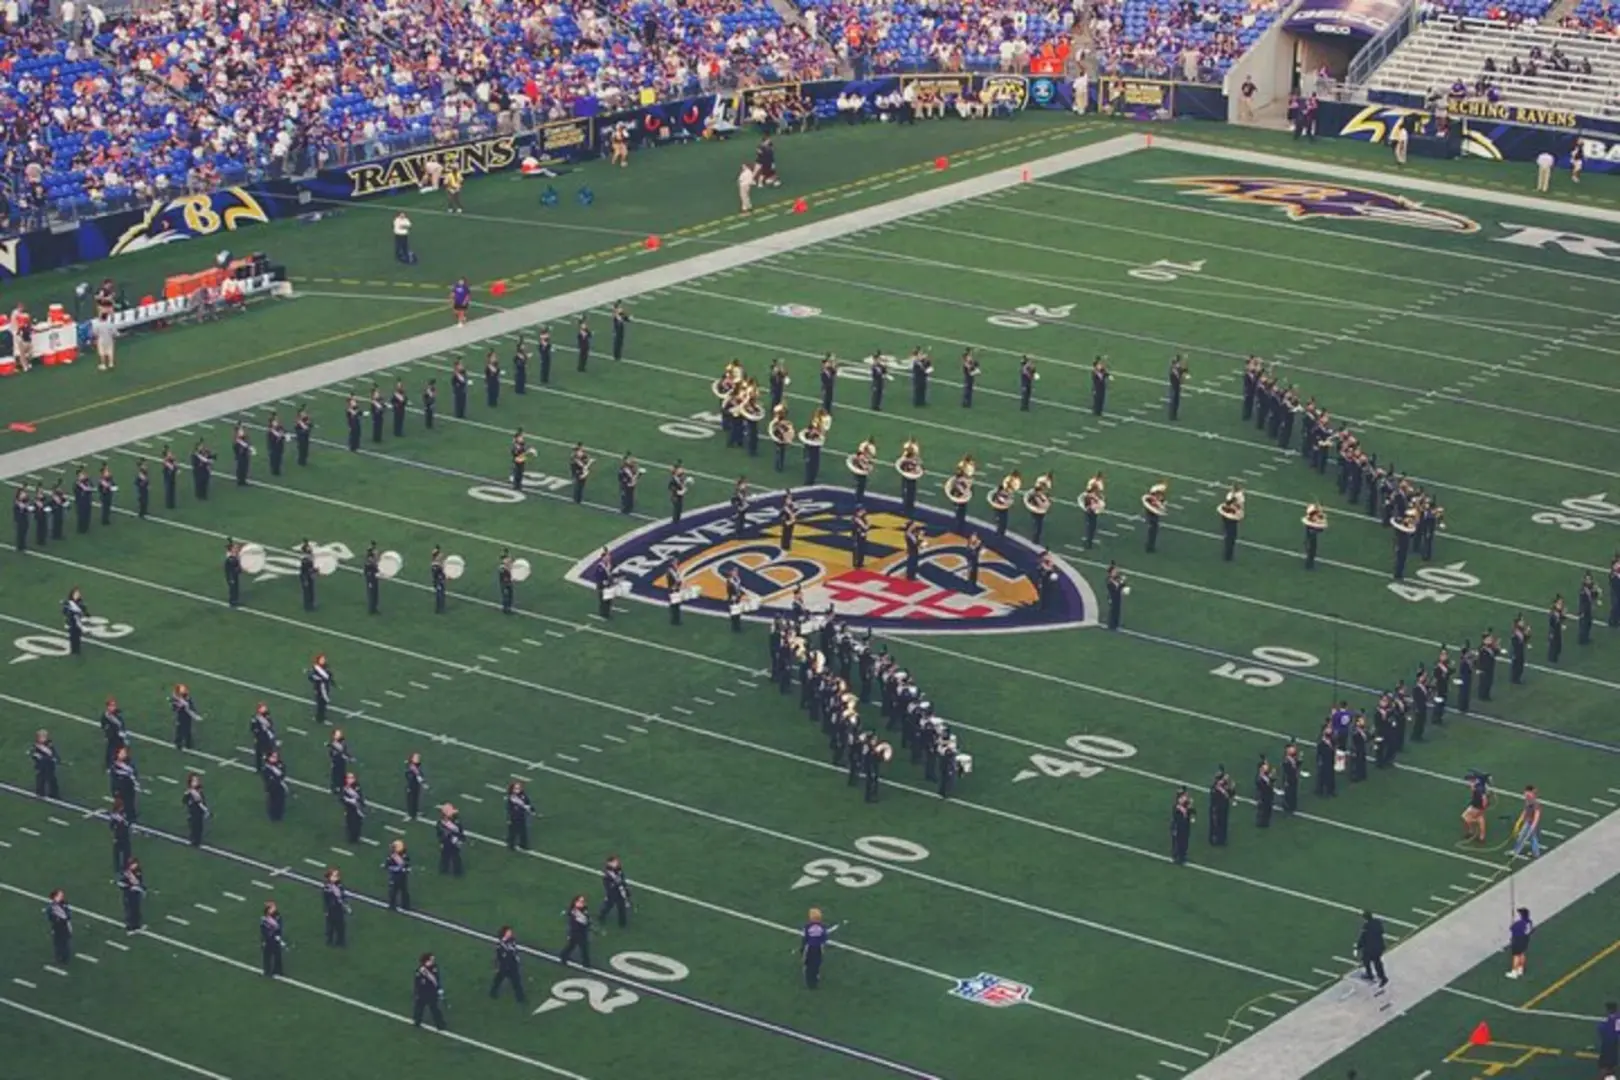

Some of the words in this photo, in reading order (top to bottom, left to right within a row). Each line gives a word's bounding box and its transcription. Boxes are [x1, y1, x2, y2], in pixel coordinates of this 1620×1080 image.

[1447, 100, 1510, 121] RCHING
[1516, 107, 1577, 127] RAVENS
[347, 137, 516, 197] RAVENS
[1531, 498, 1620, 531] 30
[1387, 568, 1480, 602] 40
[1210, 646, 1320, 687] 50
[1029, 735, 1138, 778] 40
[802, 836, 930, 888] 30
[551, 951, 690, 1014] 20
